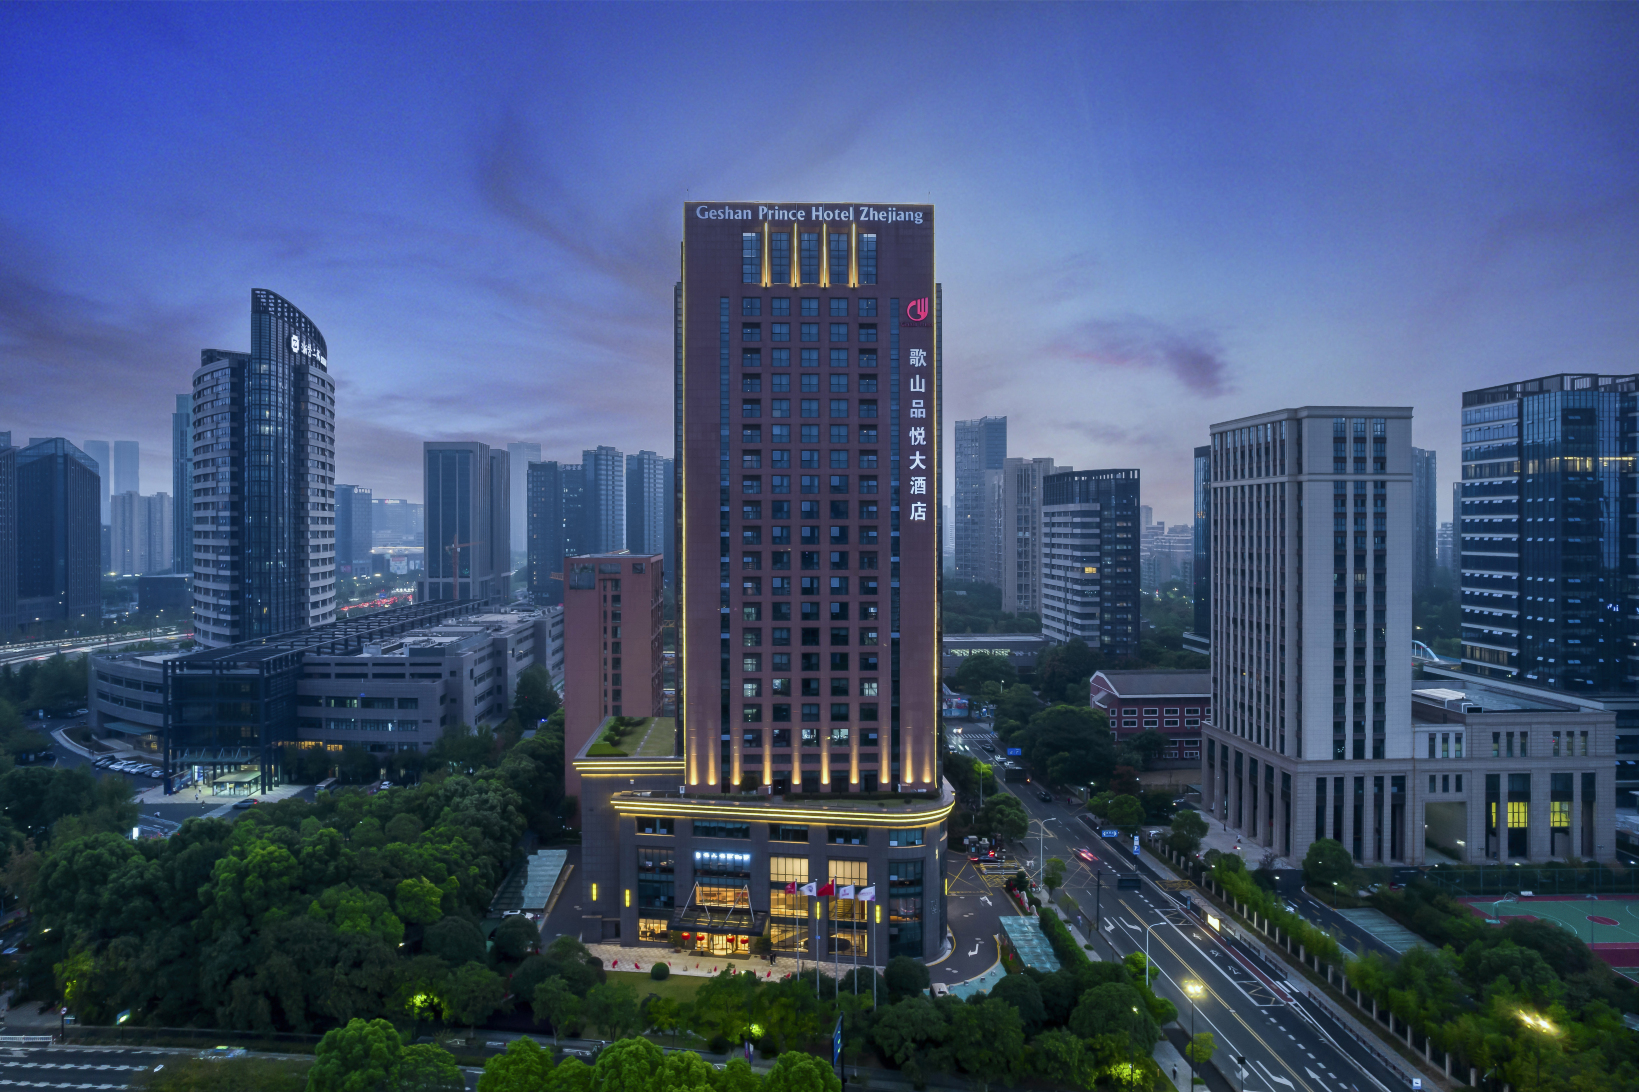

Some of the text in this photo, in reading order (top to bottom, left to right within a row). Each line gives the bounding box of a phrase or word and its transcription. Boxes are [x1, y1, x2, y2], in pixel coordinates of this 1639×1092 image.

[696, 205, 924, 225] Geshan Prince Hotel Zhejiang
[909, 348, 927, 521] 歌山品悦大酒店
